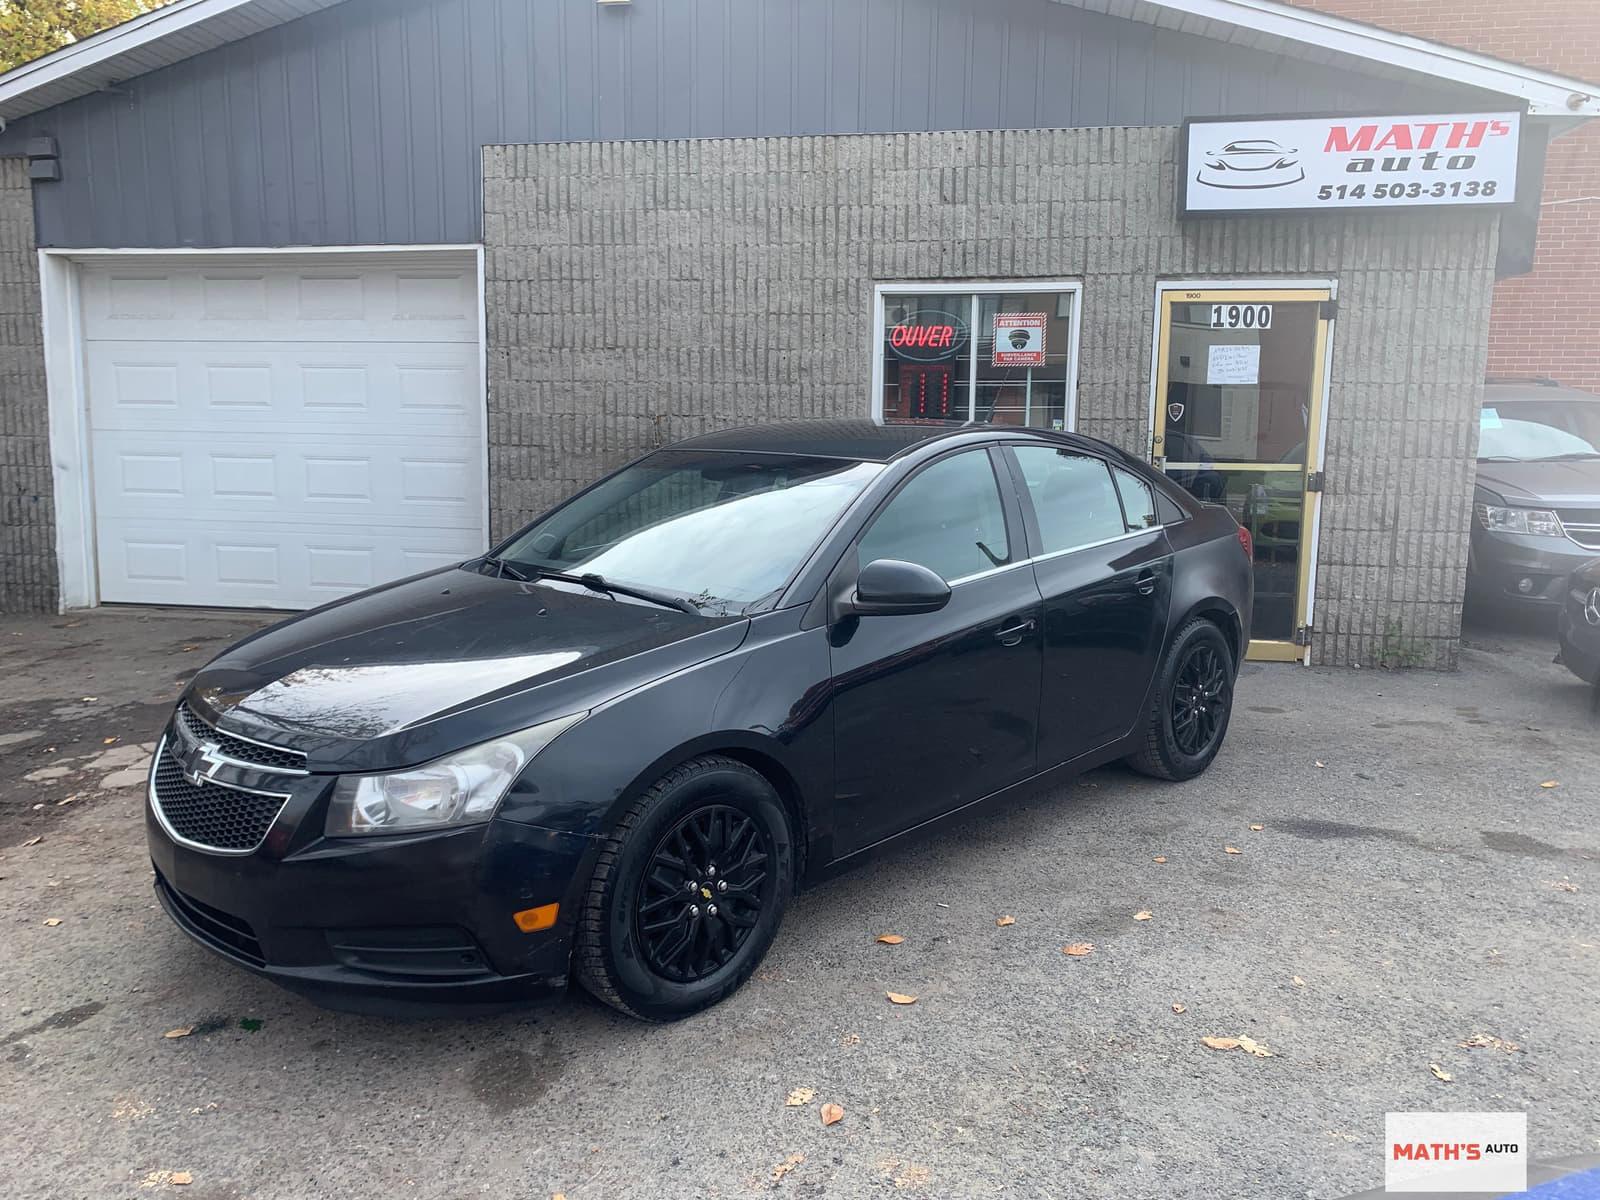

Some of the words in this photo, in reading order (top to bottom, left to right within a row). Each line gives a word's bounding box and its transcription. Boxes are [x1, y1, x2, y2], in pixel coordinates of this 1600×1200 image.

[1345, 151, 1476, 173] auto
[1316, 184, 1366, 200] 514
[1373, 180, 1497, 199] 503-3138
[999, 319, 1041, 327] ATTENTION
[1212, 305, 1271, 328] 1900
